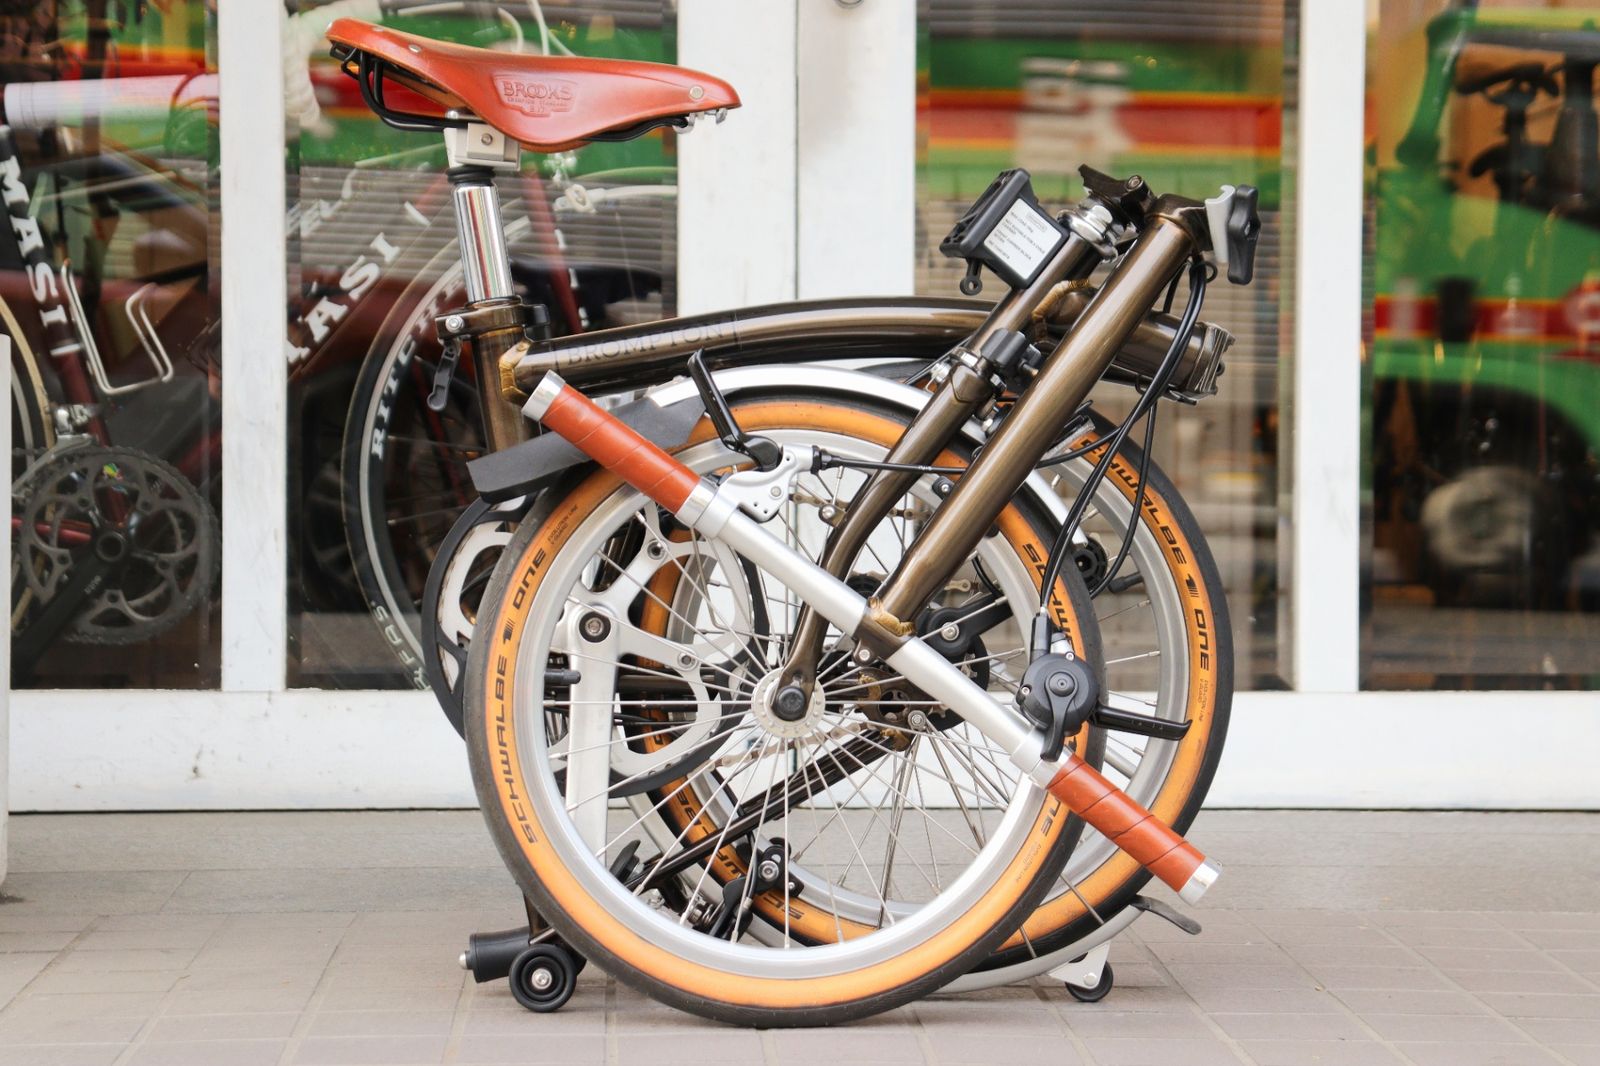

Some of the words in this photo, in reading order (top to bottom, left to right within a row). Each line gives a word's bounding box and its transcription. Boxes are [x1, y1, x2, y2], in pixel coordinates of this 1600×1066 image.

[503, 81, 573, 100] BROOKS
[0, 155, 68, 327] MASI
[371, 276, 465, 460] RITCHE
[567, 324, 727, 366] BROMPTON
[512, 547, 547, 610] ONE
[1194, 608, 1210, 672] ONE
[494, 655, 537, 844] SCHWALBE
[1041, 796, 1061, 837] NE
